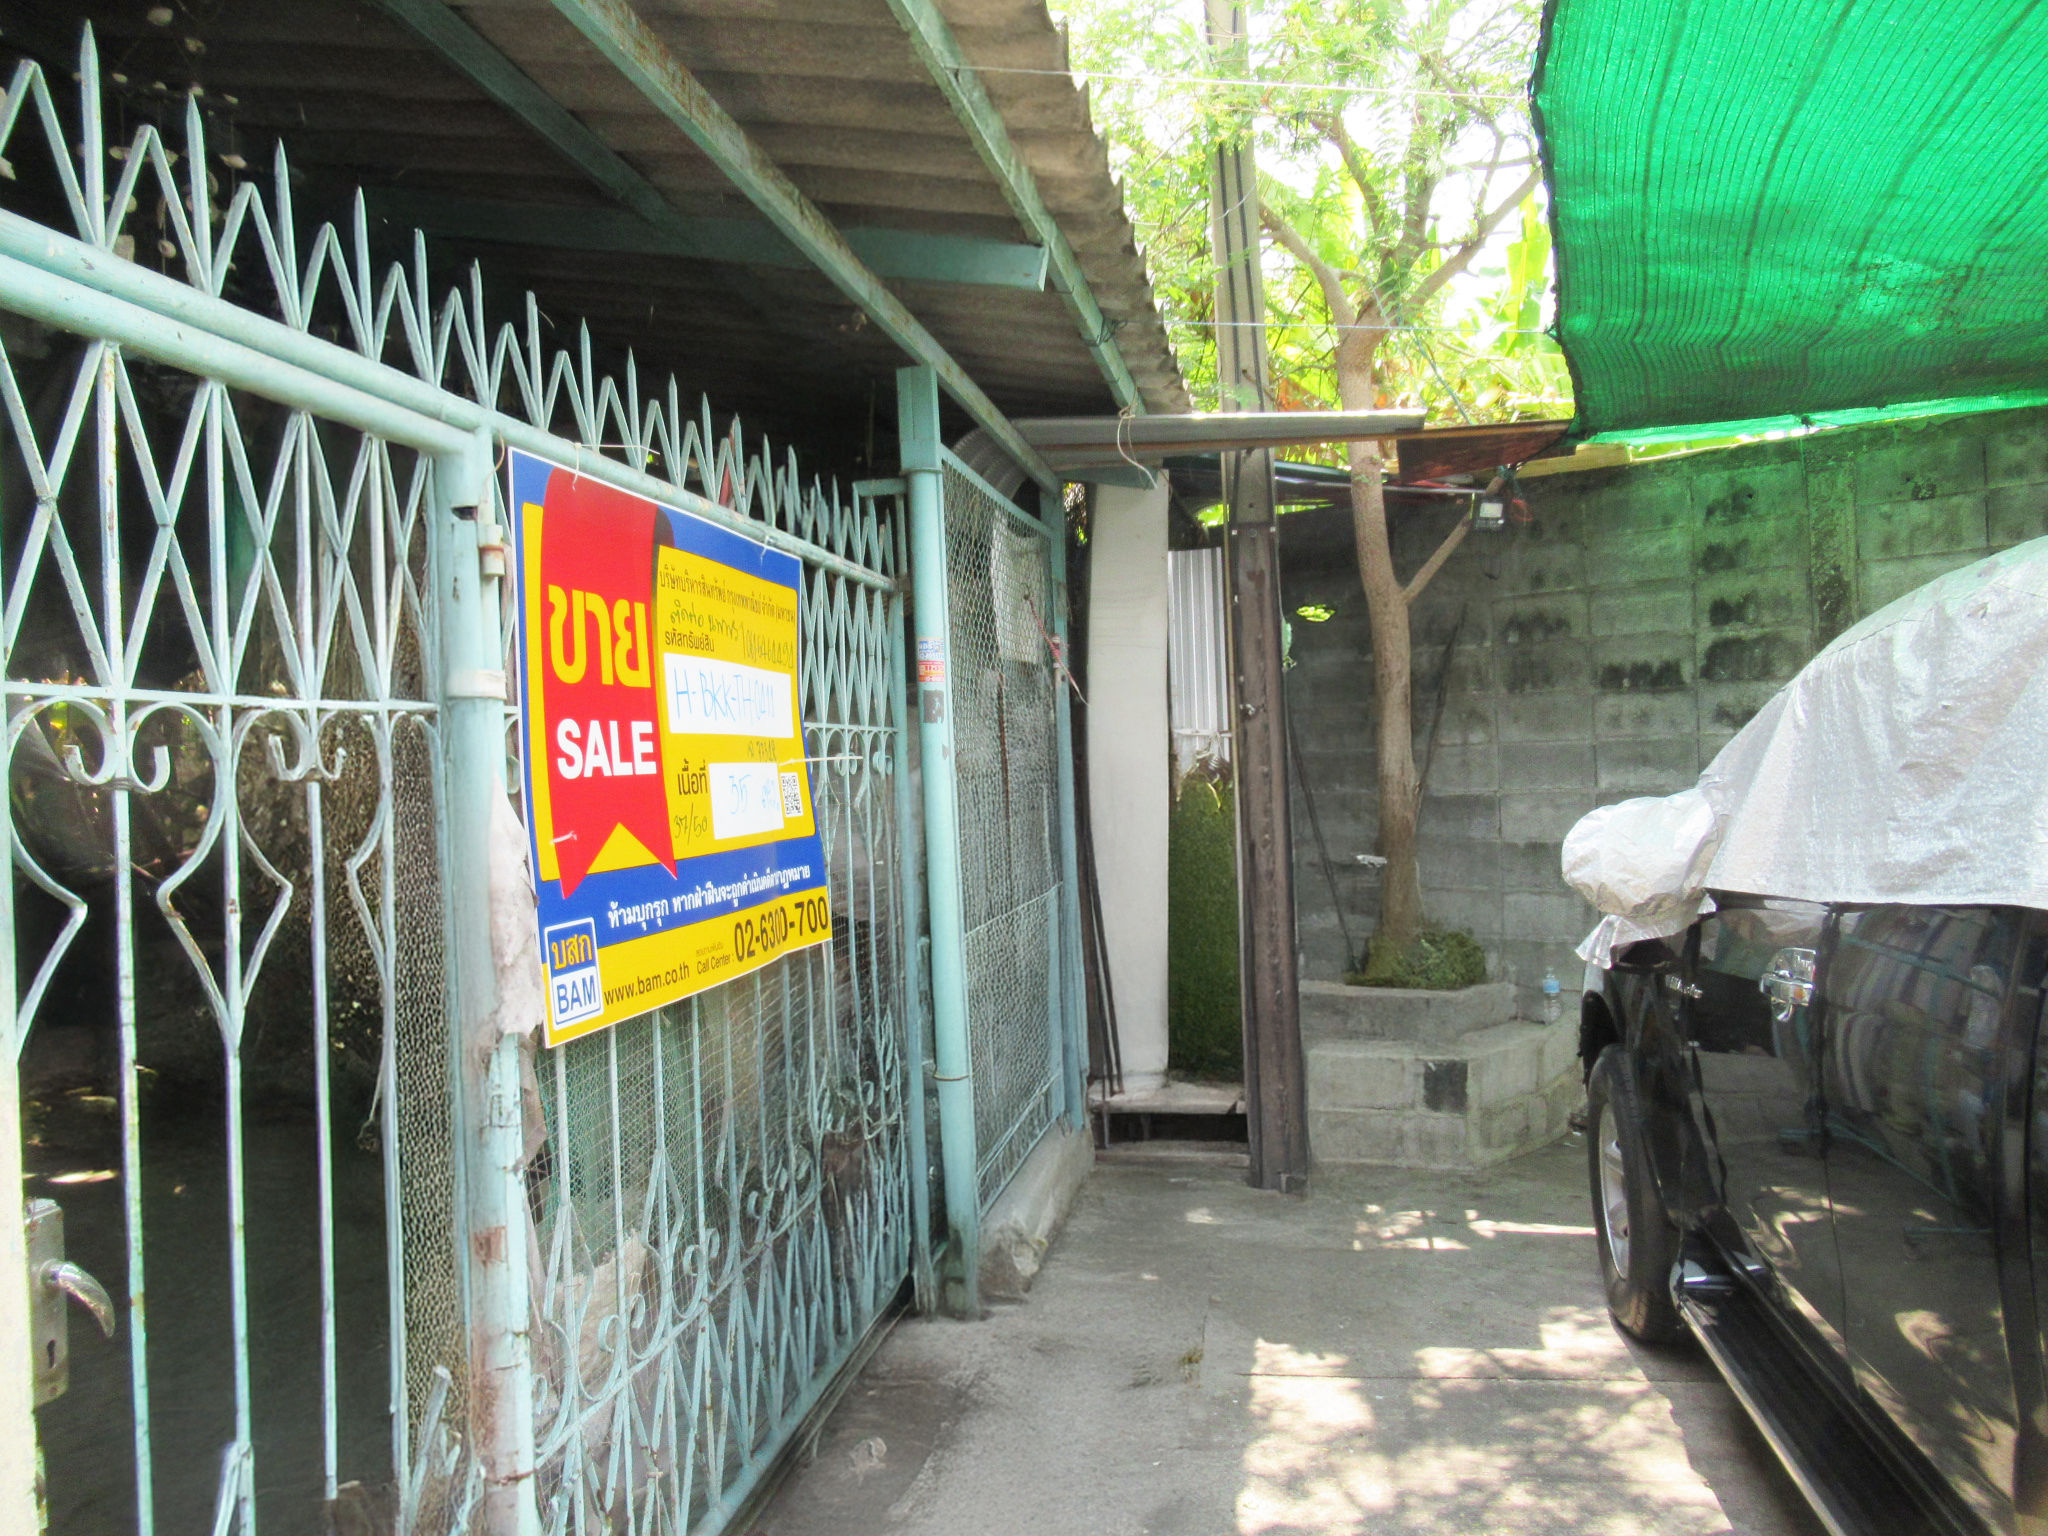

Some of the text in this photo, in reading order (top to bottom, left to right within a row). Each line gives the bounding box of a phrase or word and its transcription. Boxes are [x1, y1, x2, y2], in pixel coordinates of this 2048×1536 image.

[548, 584, 651, 688] ขาย
[664, 628, 715, 652] รหัสทรัพย์สิน
[557, 718, 657, 780] SALE
[677, 758, 709, 795] เนื้อที่
[607, 899, 670, 931] ห้ามบุกรุก
[734, 896, 829, 962] 02-6300-700
[552, 934, 592, 969] บสก
[697, 959, 710, 974] Call
[557, 976, 596, 1014] BAM
[604, 961, 690, 1005] www.bam.co.th
